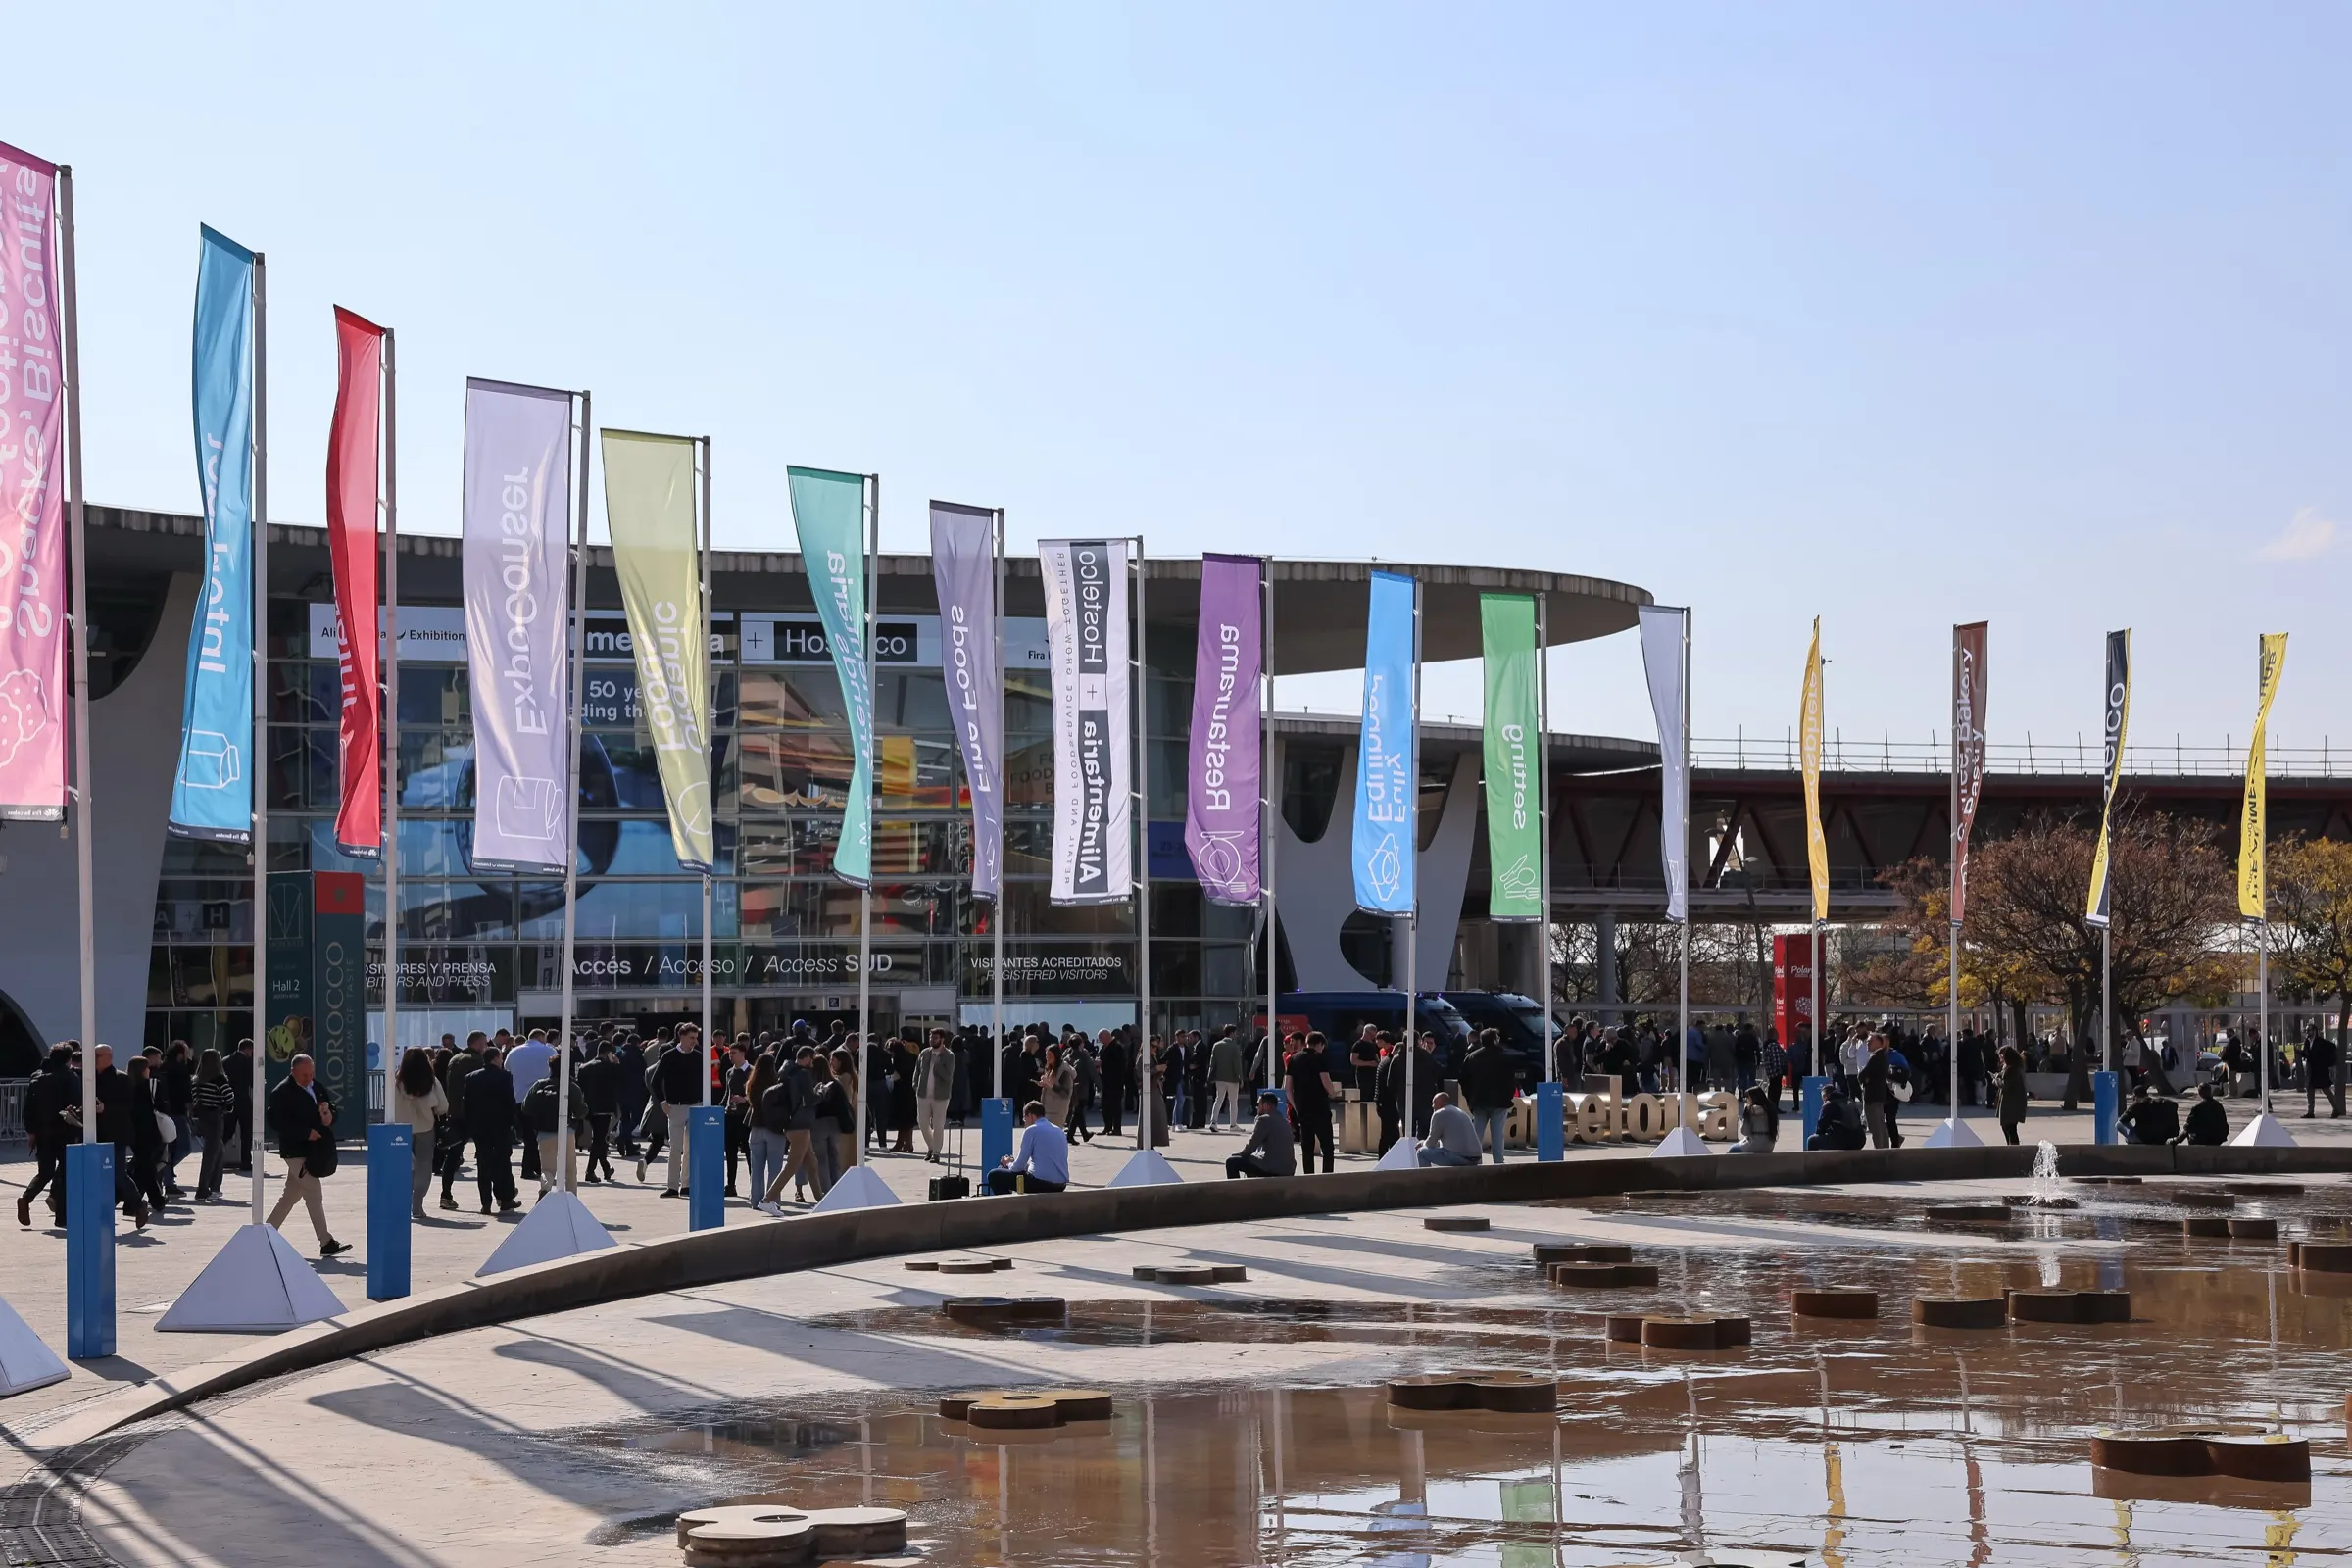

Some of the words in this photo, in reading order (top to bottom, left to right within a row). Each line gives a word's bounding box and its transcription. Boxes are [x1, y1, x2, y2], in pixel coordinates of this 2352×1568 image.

[1028, 650, 1046, 661] Fira
[589, 680, 616, 699] 50
[429, 962, 439, 974] Y
[443, 962, 497, 975] PRENSA
[763, 955, 837, 973] Access
[1041, 956, 1122, 969] ACREDITADOS
[986, 969, 1057, 981] RGISTERED
[1059, 969, 1108, 981] VISITORS
[273, 979, 292, 992] Hall
[294, 979, 301, 991] 2
[416, 976, 445, 988] AND
[448, 976, 491, 988] PRESS
[325, 942, 345, 1109] MOROCCO
